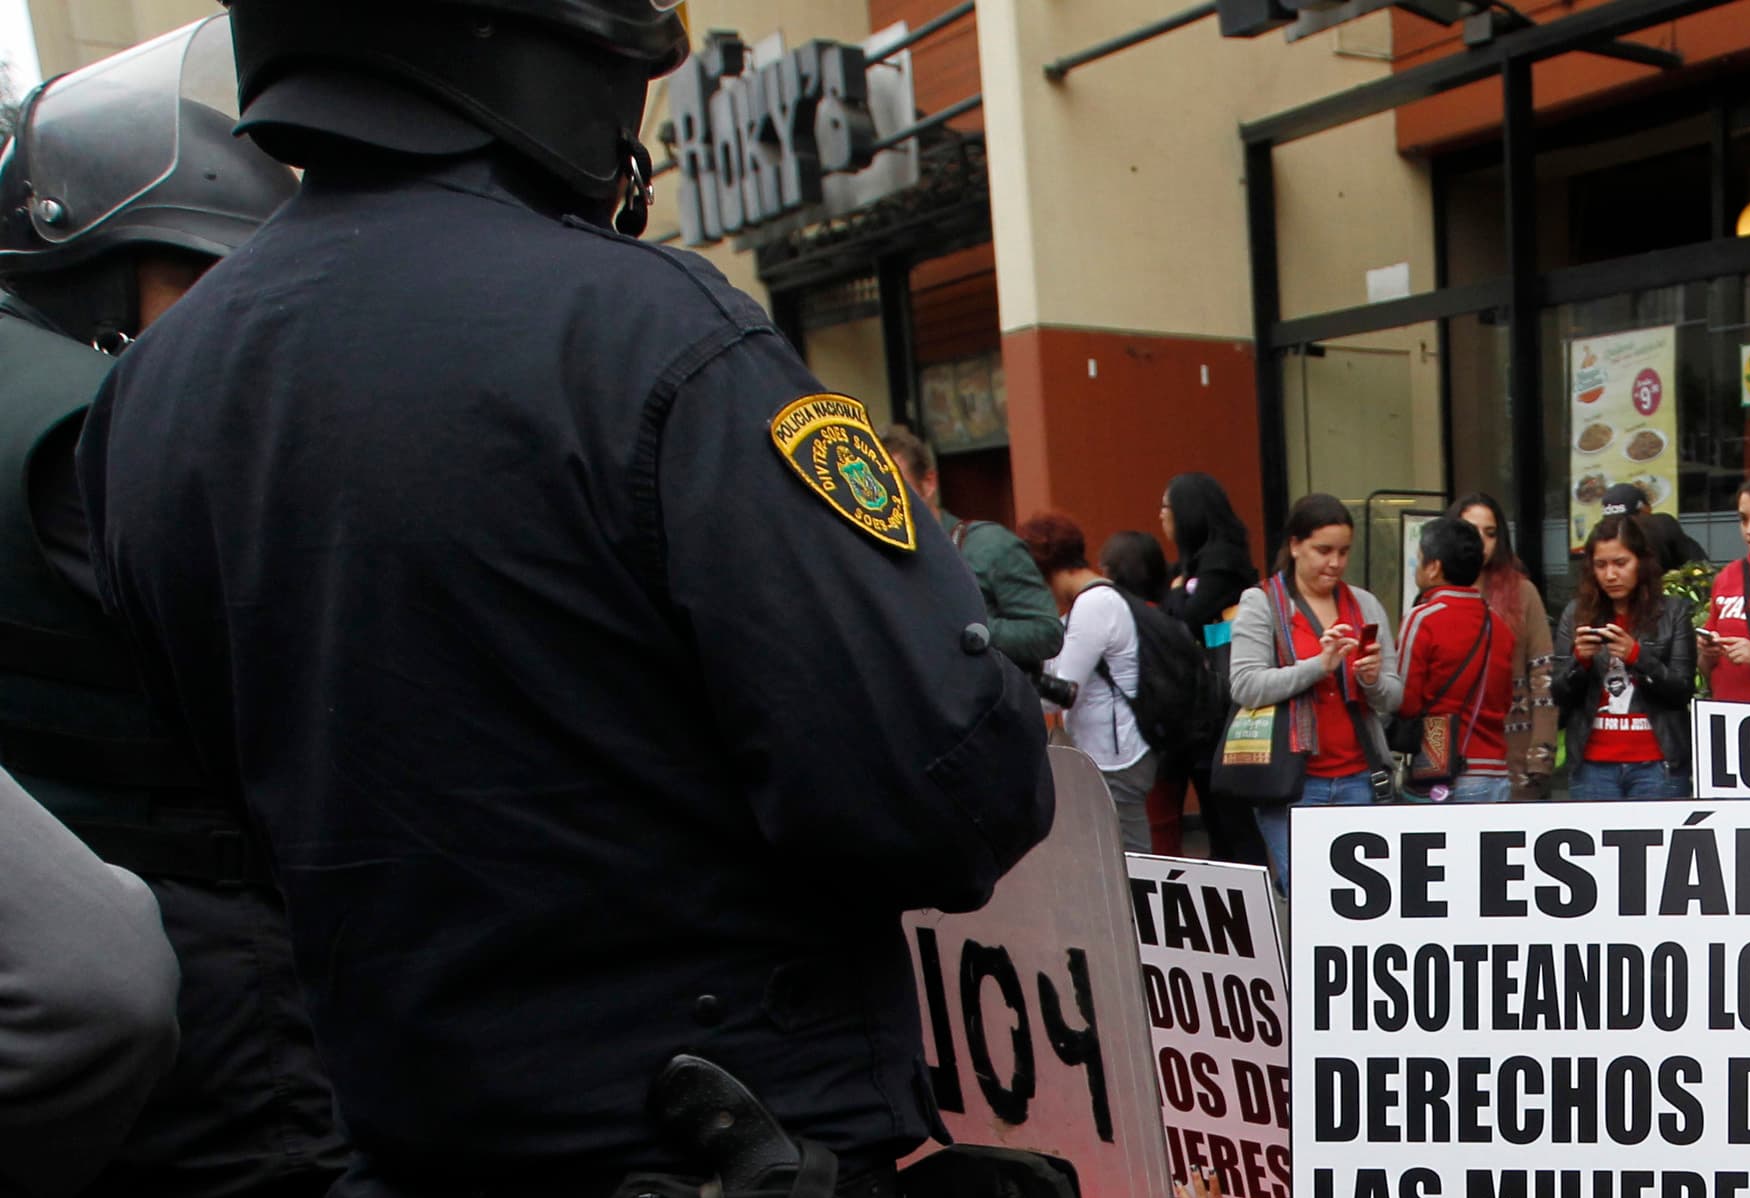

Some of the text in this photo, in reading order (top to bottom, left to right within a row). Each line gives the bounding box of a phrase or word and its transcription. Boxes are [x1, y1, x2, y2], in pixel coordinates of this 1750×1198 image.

[776, 401, 867, 444] POLICIA NACIONAL
[1330, 832, 1448, 920] SE
[1202, 971, 1283, 1047] LOS
[1314, 941, 1688, 1032] PISOTEANDO
[1159, 1046, 1289, 1129] OS DE
[1314, 1056, 1704, 1145] DERECHOS
